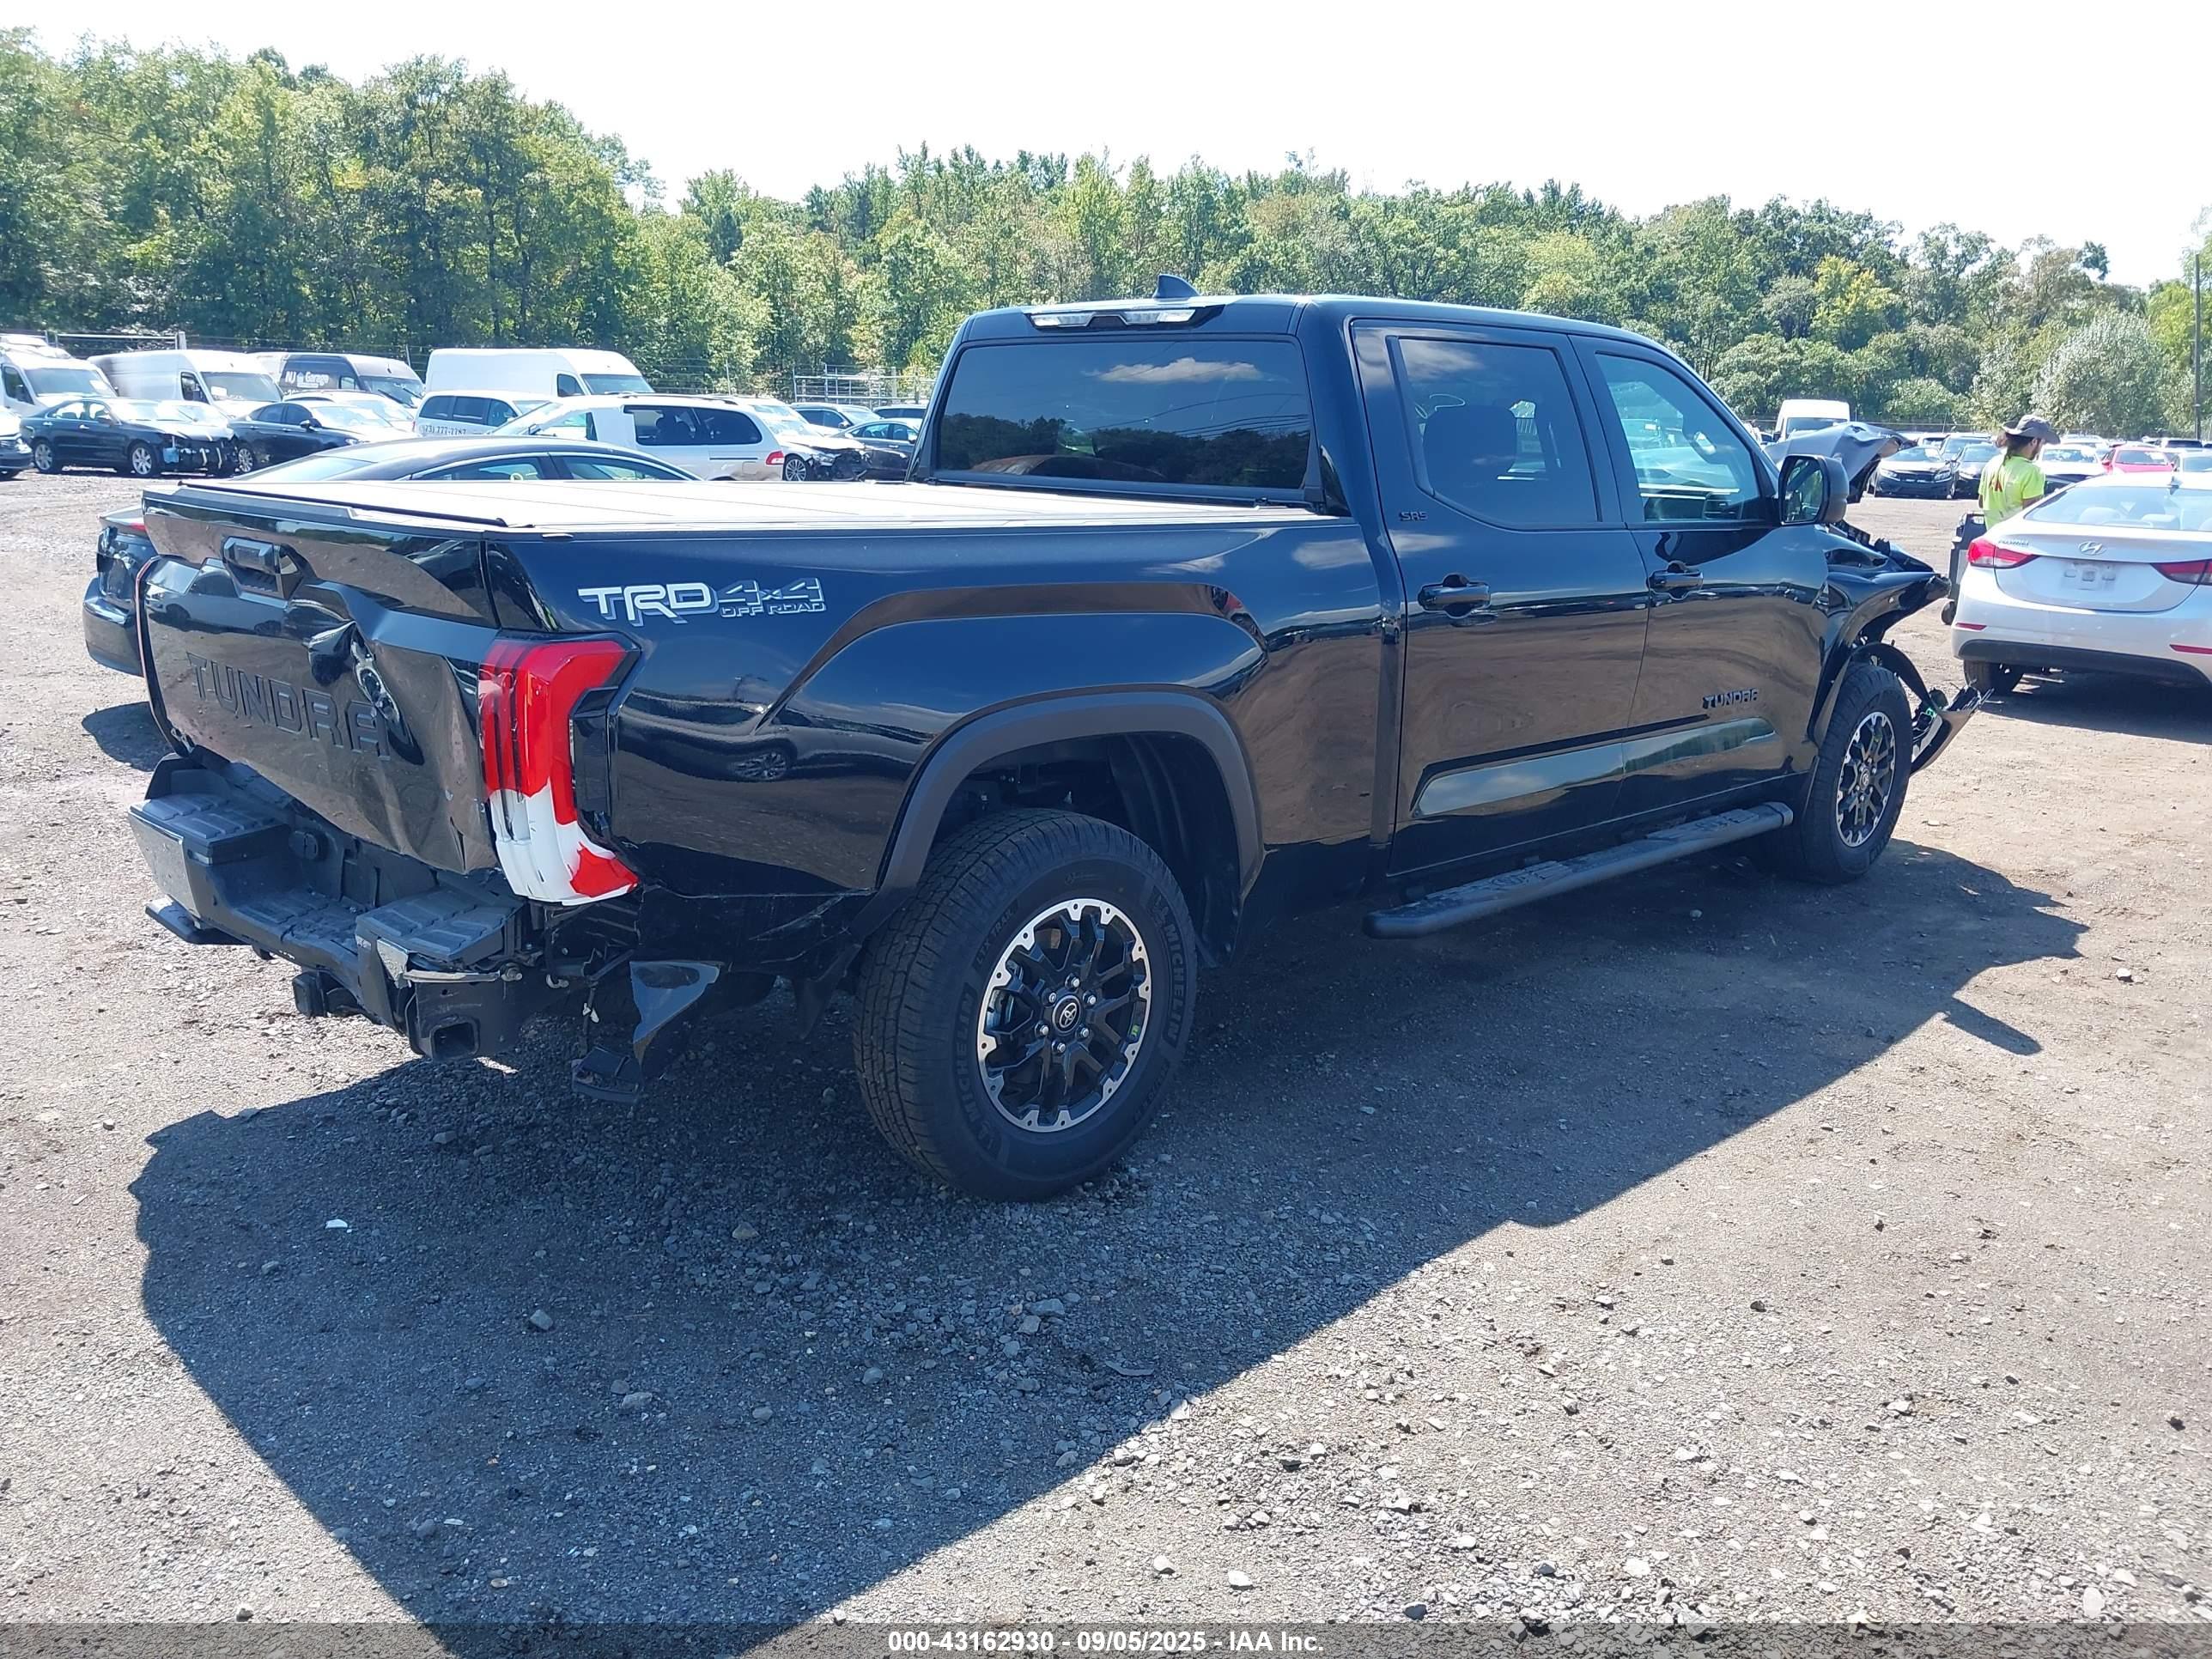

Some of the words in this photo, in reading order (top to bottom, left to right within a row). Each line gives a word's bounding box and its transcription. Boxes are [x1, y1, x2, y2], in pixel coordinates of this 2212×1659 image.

[285, 371, 296, 384] NJ
[306, 371, 329, 386] Garage
[577, 582, 719, 627] TRD
[721, 605, 764, 618] OFF
[768, 603, 827, 615] ROAD
[186, 651, 391, 761] TUNDRA
[1703, 688, 1759, 709] TUNDRA
[956, 992, 982, 1122] MICHELIN
